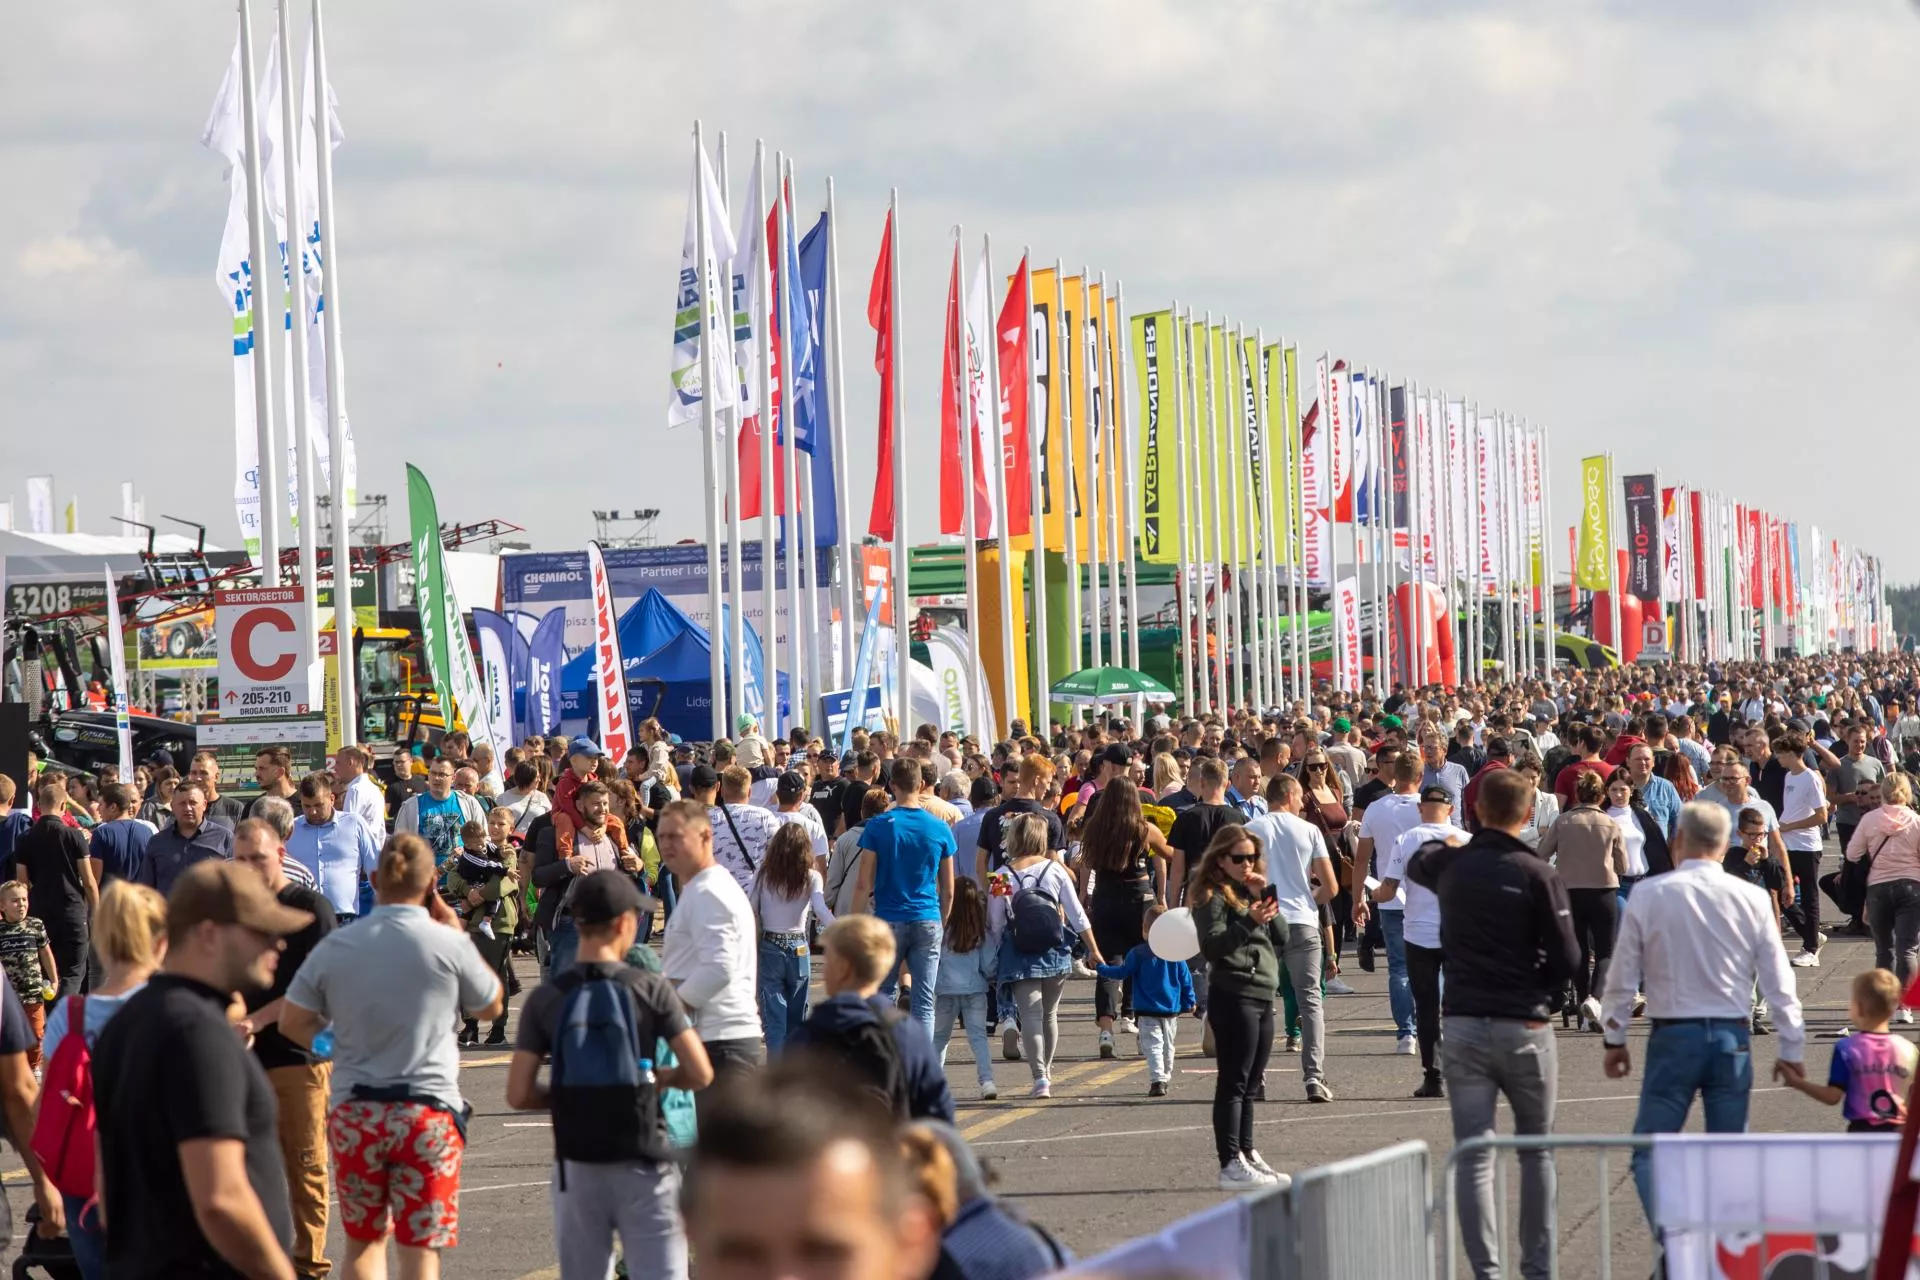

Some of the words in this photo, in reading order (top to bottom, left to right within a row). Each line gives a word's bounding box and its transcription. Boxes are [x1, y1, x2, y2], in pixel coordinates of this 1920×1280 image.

[524, 573, 583, 584] CHEMIROL
[640, 567, 682, 578] Partner
[13, 585, 72, 614] 3208
[225, 591, 295, 603] SEKTOR/SECTOR
[1647, 627, 1663, 644] D
[230, 607, 297, 682] C
[319, 635, 332, 652] 2
[242, 691, 292, 705] 205-210
[240, 706, 289, 716] DROGA/ROUTE
[301, 704, 308, 713] 2
[326, 758, 336, 773] 2
